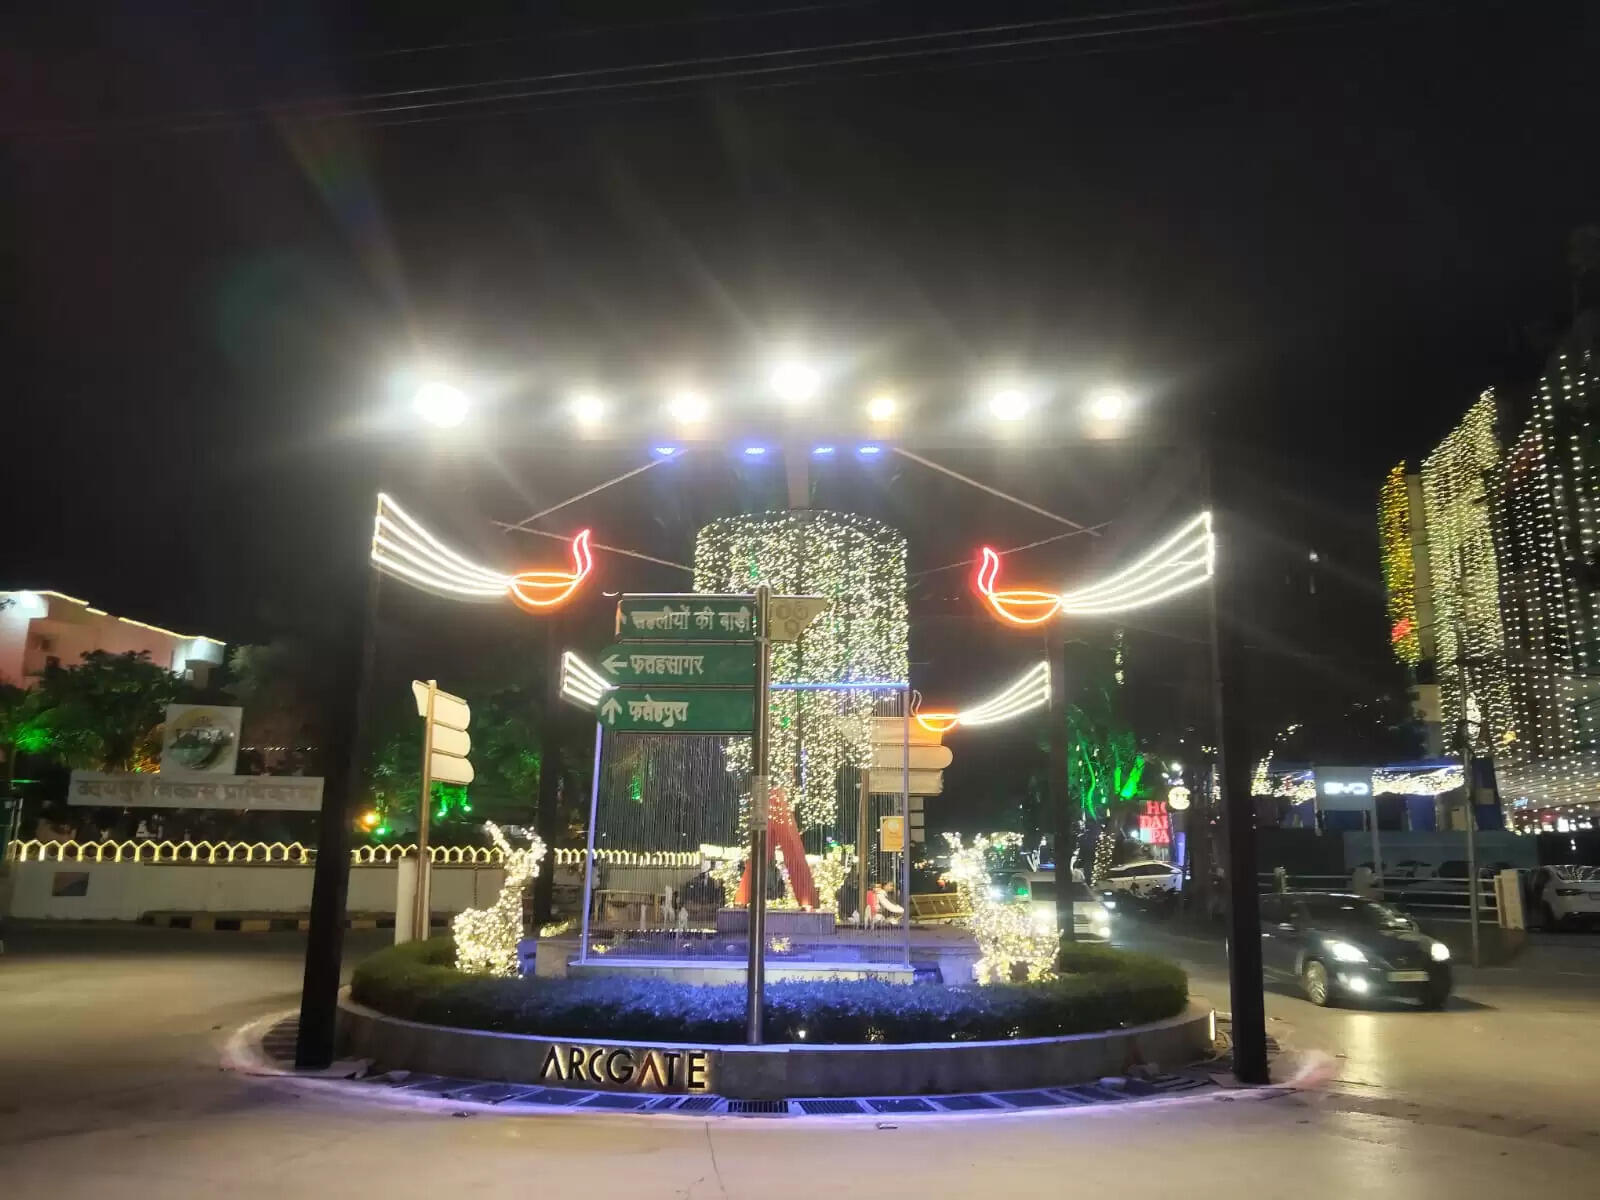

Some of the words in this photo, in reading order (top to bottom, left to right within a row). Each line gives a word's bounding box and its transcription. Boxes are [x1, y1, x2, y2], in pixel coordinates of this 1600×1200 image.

[694, 605, 715, 630] की
[718, 605, 751, 633] बाड़ी
[630, 654, 704, 675] फतहसागर
[540, 1045, 706, 1089] ARCGATE
